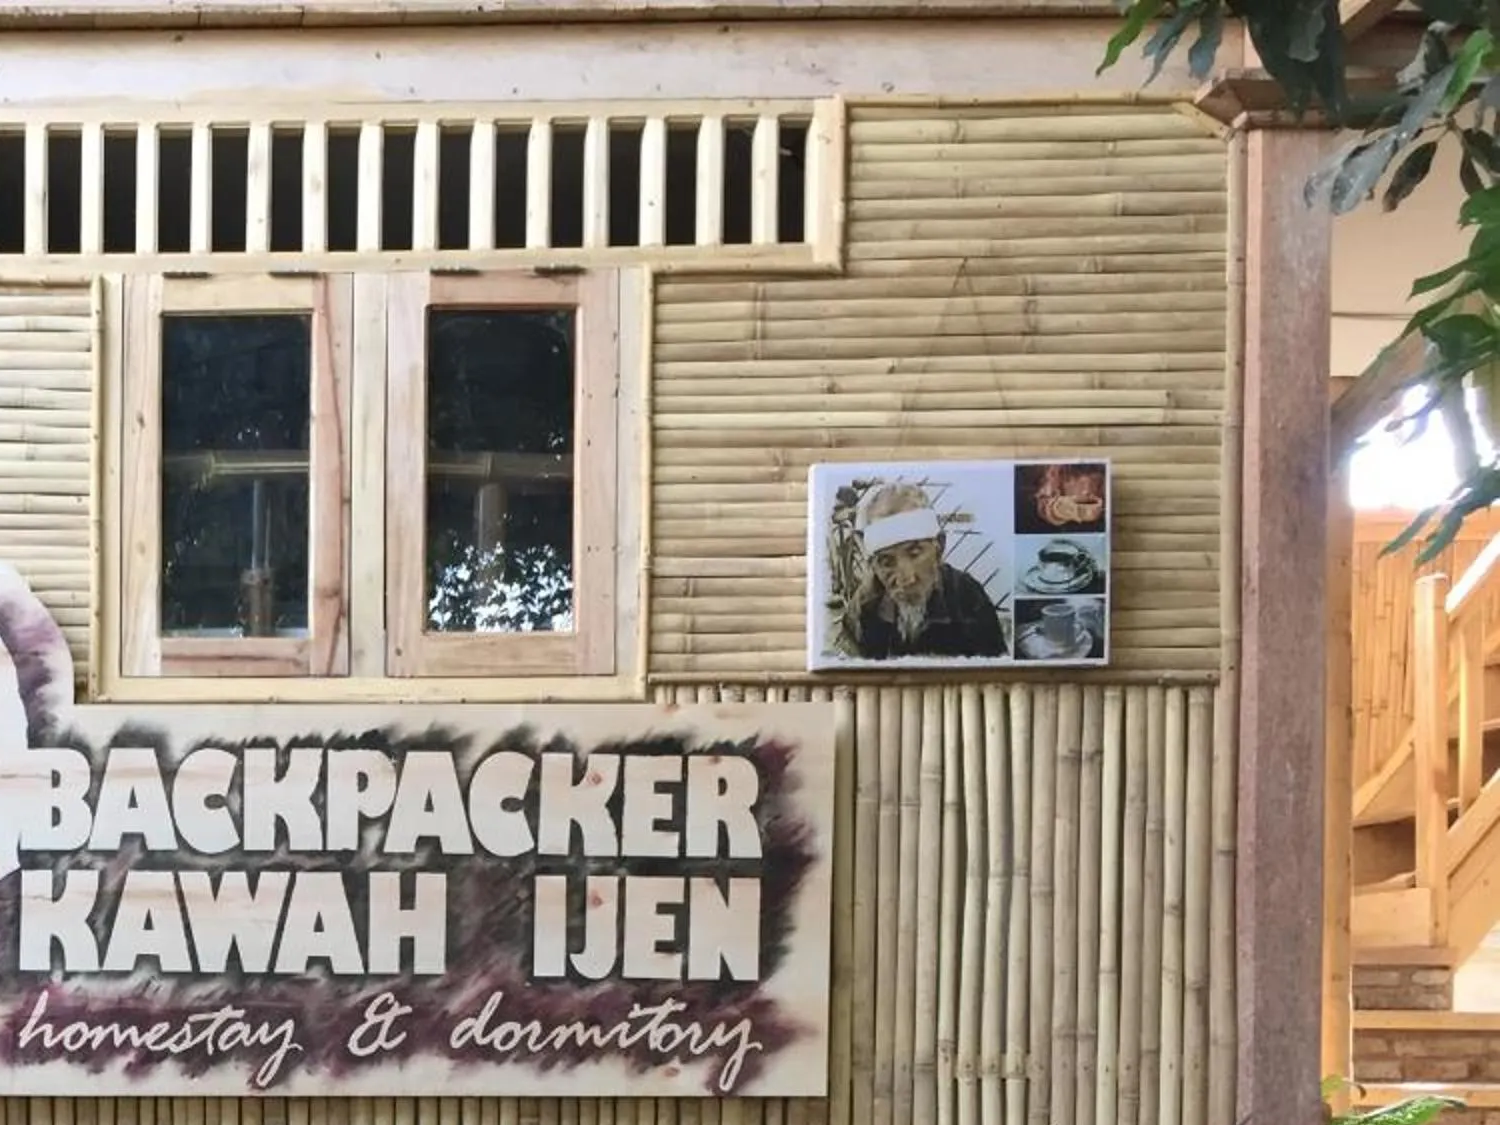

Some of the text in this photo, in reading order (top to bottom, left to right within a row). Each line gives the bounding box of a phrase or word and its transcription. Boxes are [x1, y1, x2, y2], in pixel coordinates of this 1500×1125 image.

[20, 747, 763, 858] BACKPACKER
[18, 868, 761, 981] KAWAH IJEN
[18, 990, 763, 1092] homestay & dormitory
